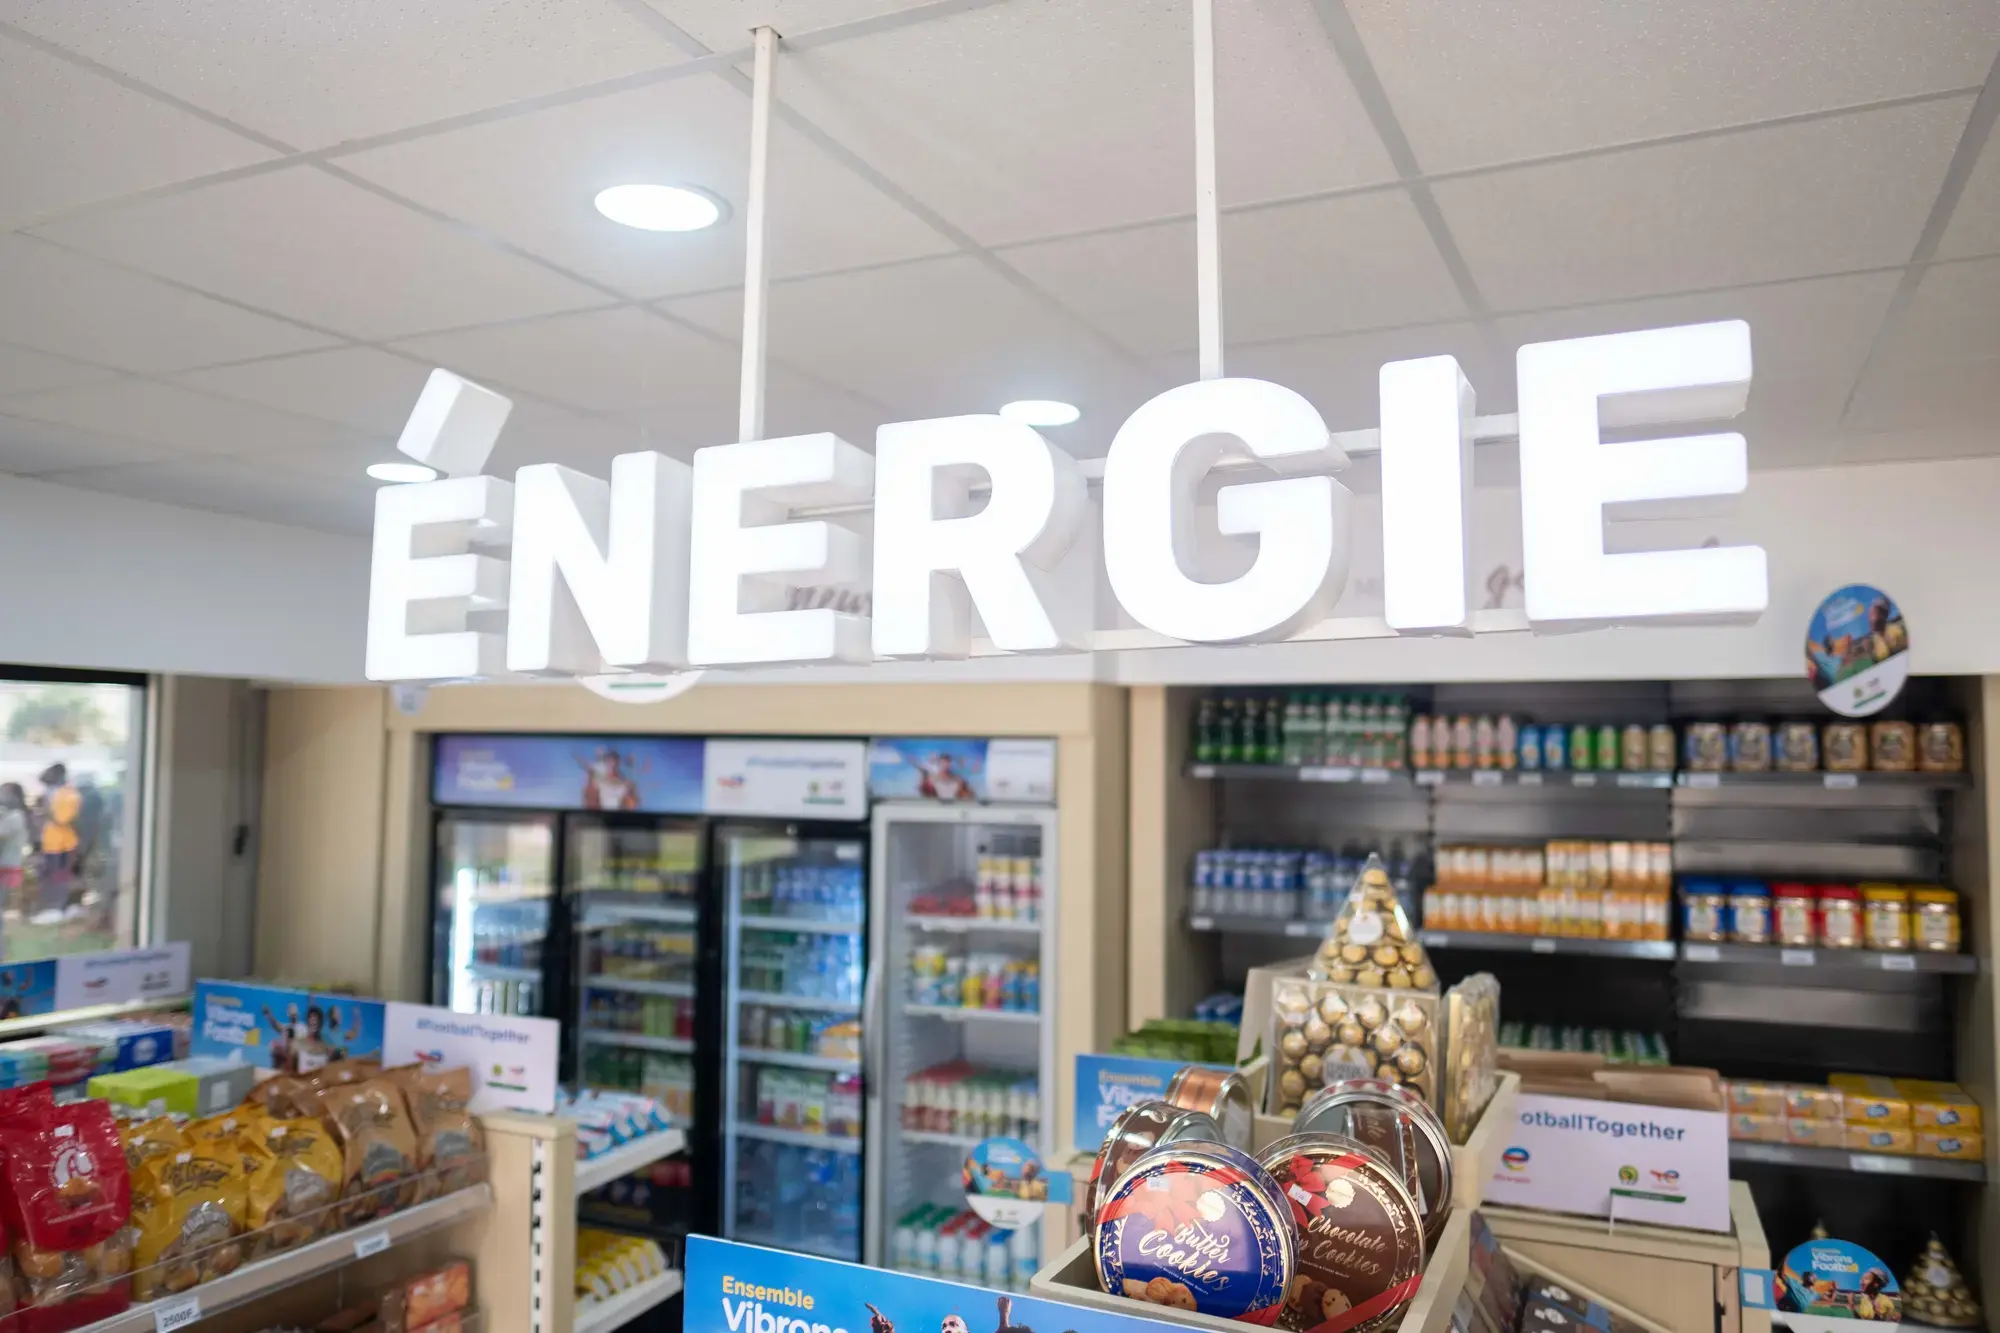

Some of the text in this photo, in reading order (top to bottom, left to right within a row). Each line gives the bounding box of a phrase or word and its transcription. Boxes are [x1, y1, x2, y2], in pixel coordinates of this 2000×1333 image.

[365, 318, 1769, 684] ÉNERGIE
[1520, 1111, 1686, 1142] otballTogether
[1174, 1218, 1231, 1264] Butter
[1308, 1214, 1388, 1253] Chocolate
[1138, 1229, 1233, 1291] Cookies
[1313, 1240, 1382, 1275] Cookies
[722, 1275, 815, 1310] Ensemble
[722, 1297, 849, 1333] Vibro
